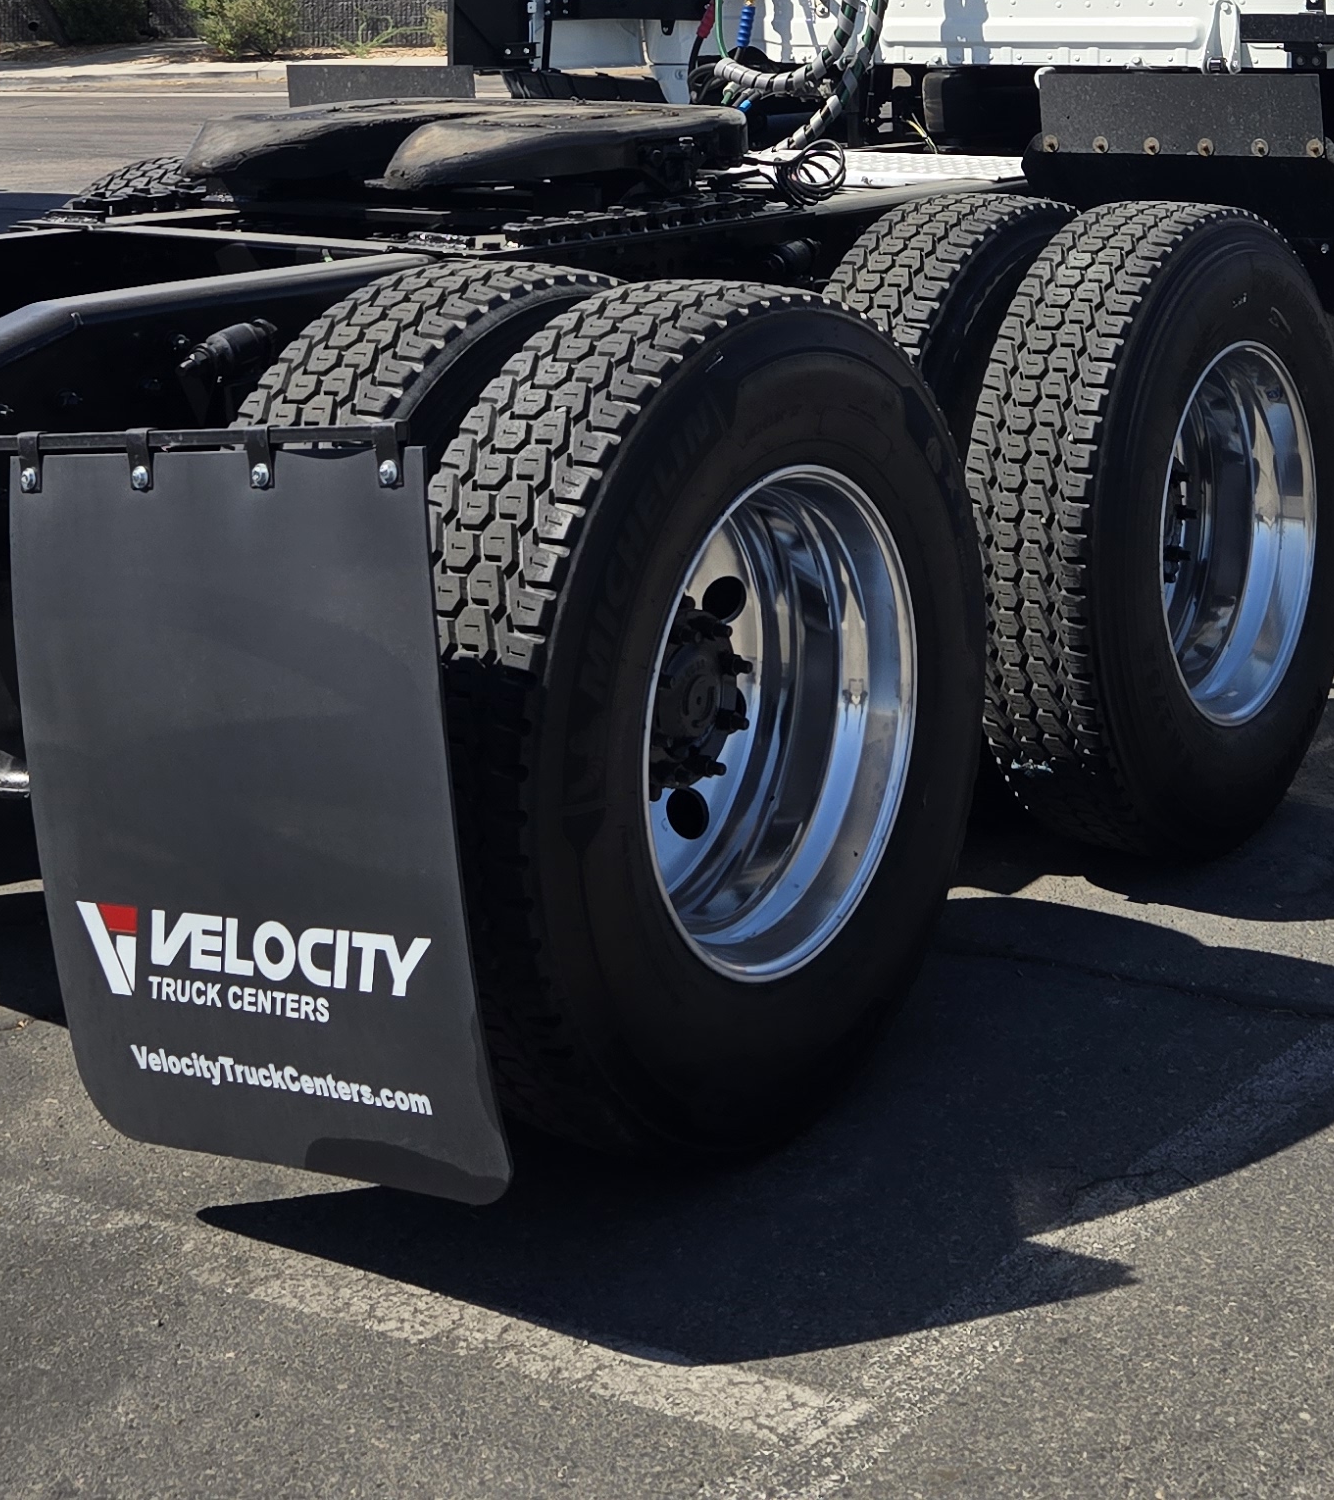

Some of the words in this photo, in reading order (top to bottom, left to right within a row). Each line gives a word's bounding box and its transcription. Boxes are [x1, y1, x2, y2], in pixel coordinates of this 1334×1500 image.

[579, 399, 710, 705] MICHELIN
[151, 909, 432, 997] VELOCITY
[148, 976, 222, 1008] TRUCK
[227, 985, 330, 1023] CENTERS
[130, 1044, 433, 1116] VelocityTruckCenters.com
